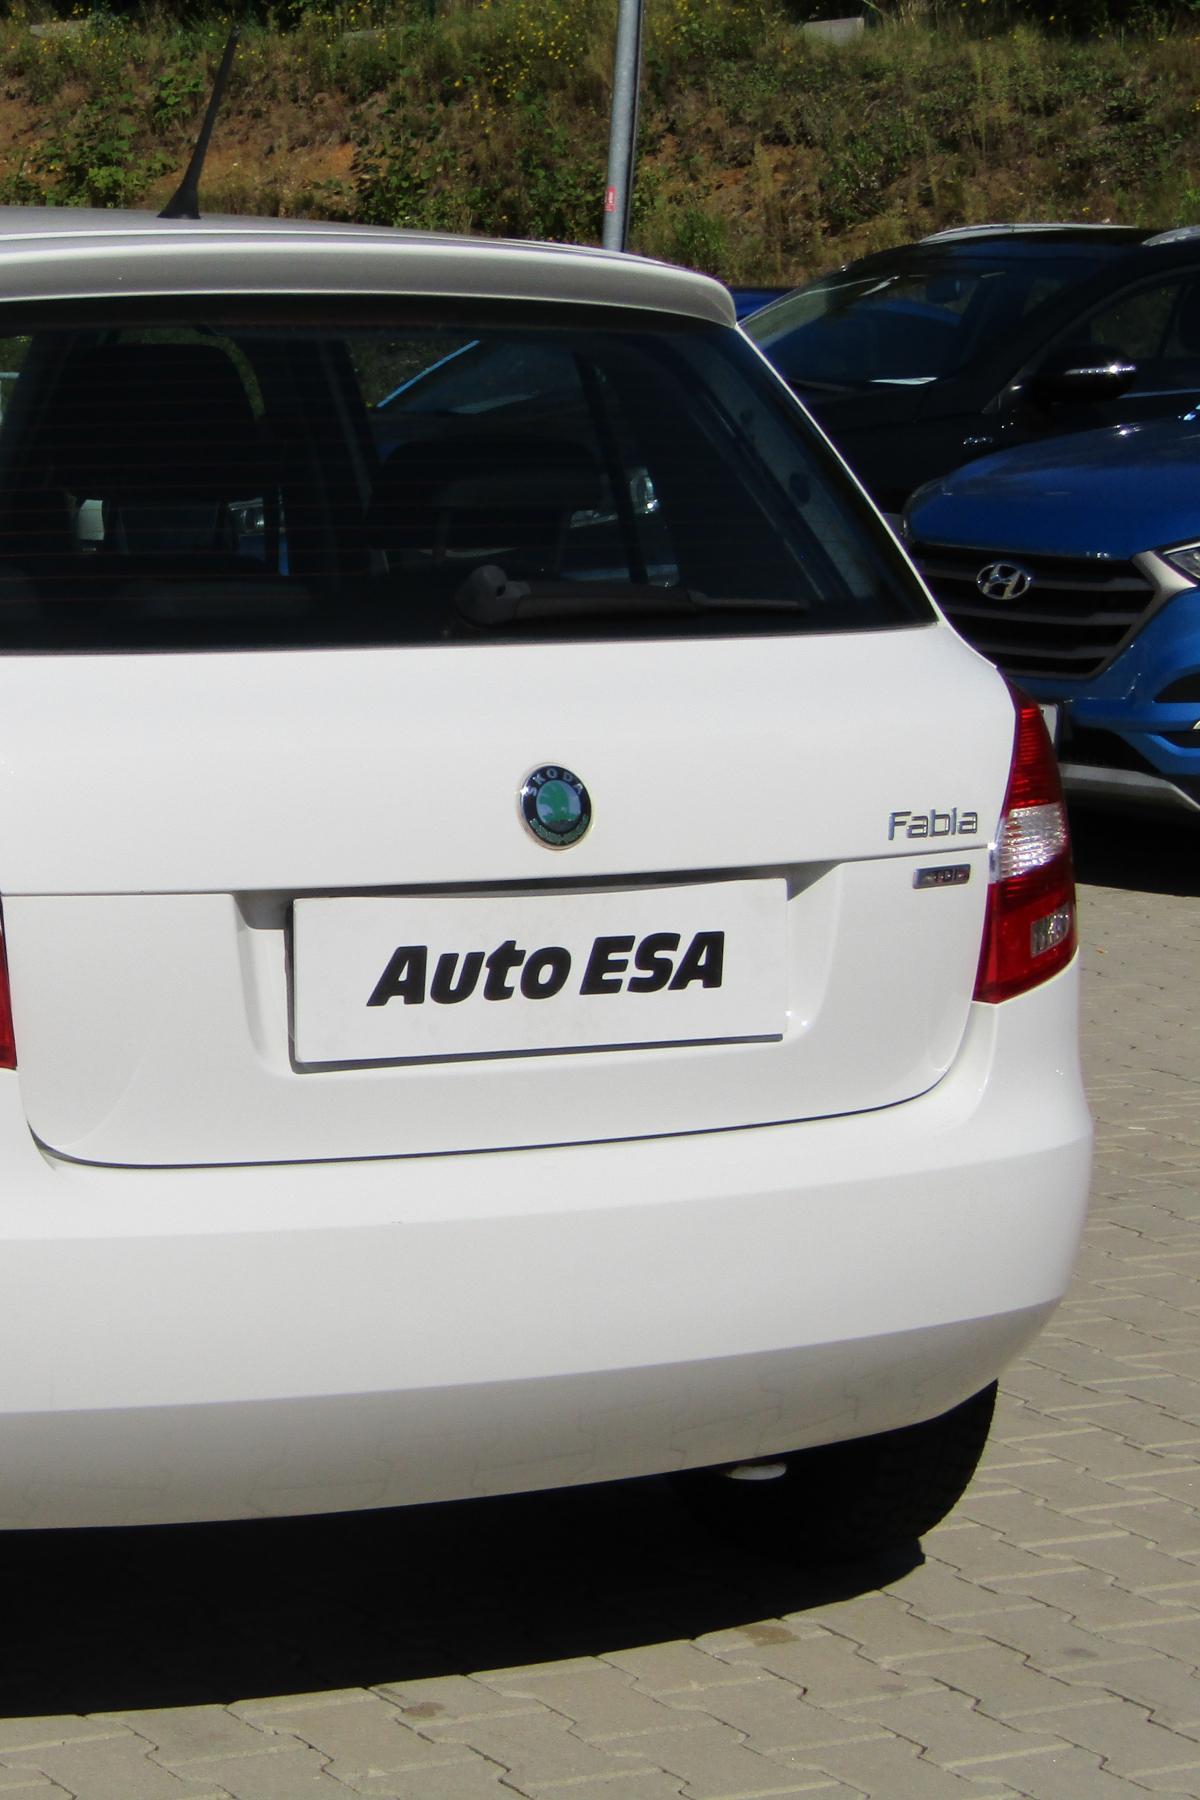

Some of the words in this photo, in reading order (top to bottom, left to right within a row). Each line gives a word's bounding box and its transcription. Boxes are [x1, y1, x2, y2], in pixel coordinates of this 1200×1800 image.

[888, 807, 978, 841] Fabia
[366, 940, 572, 1007] Auto
[579, 931, 725, 996] ESA
